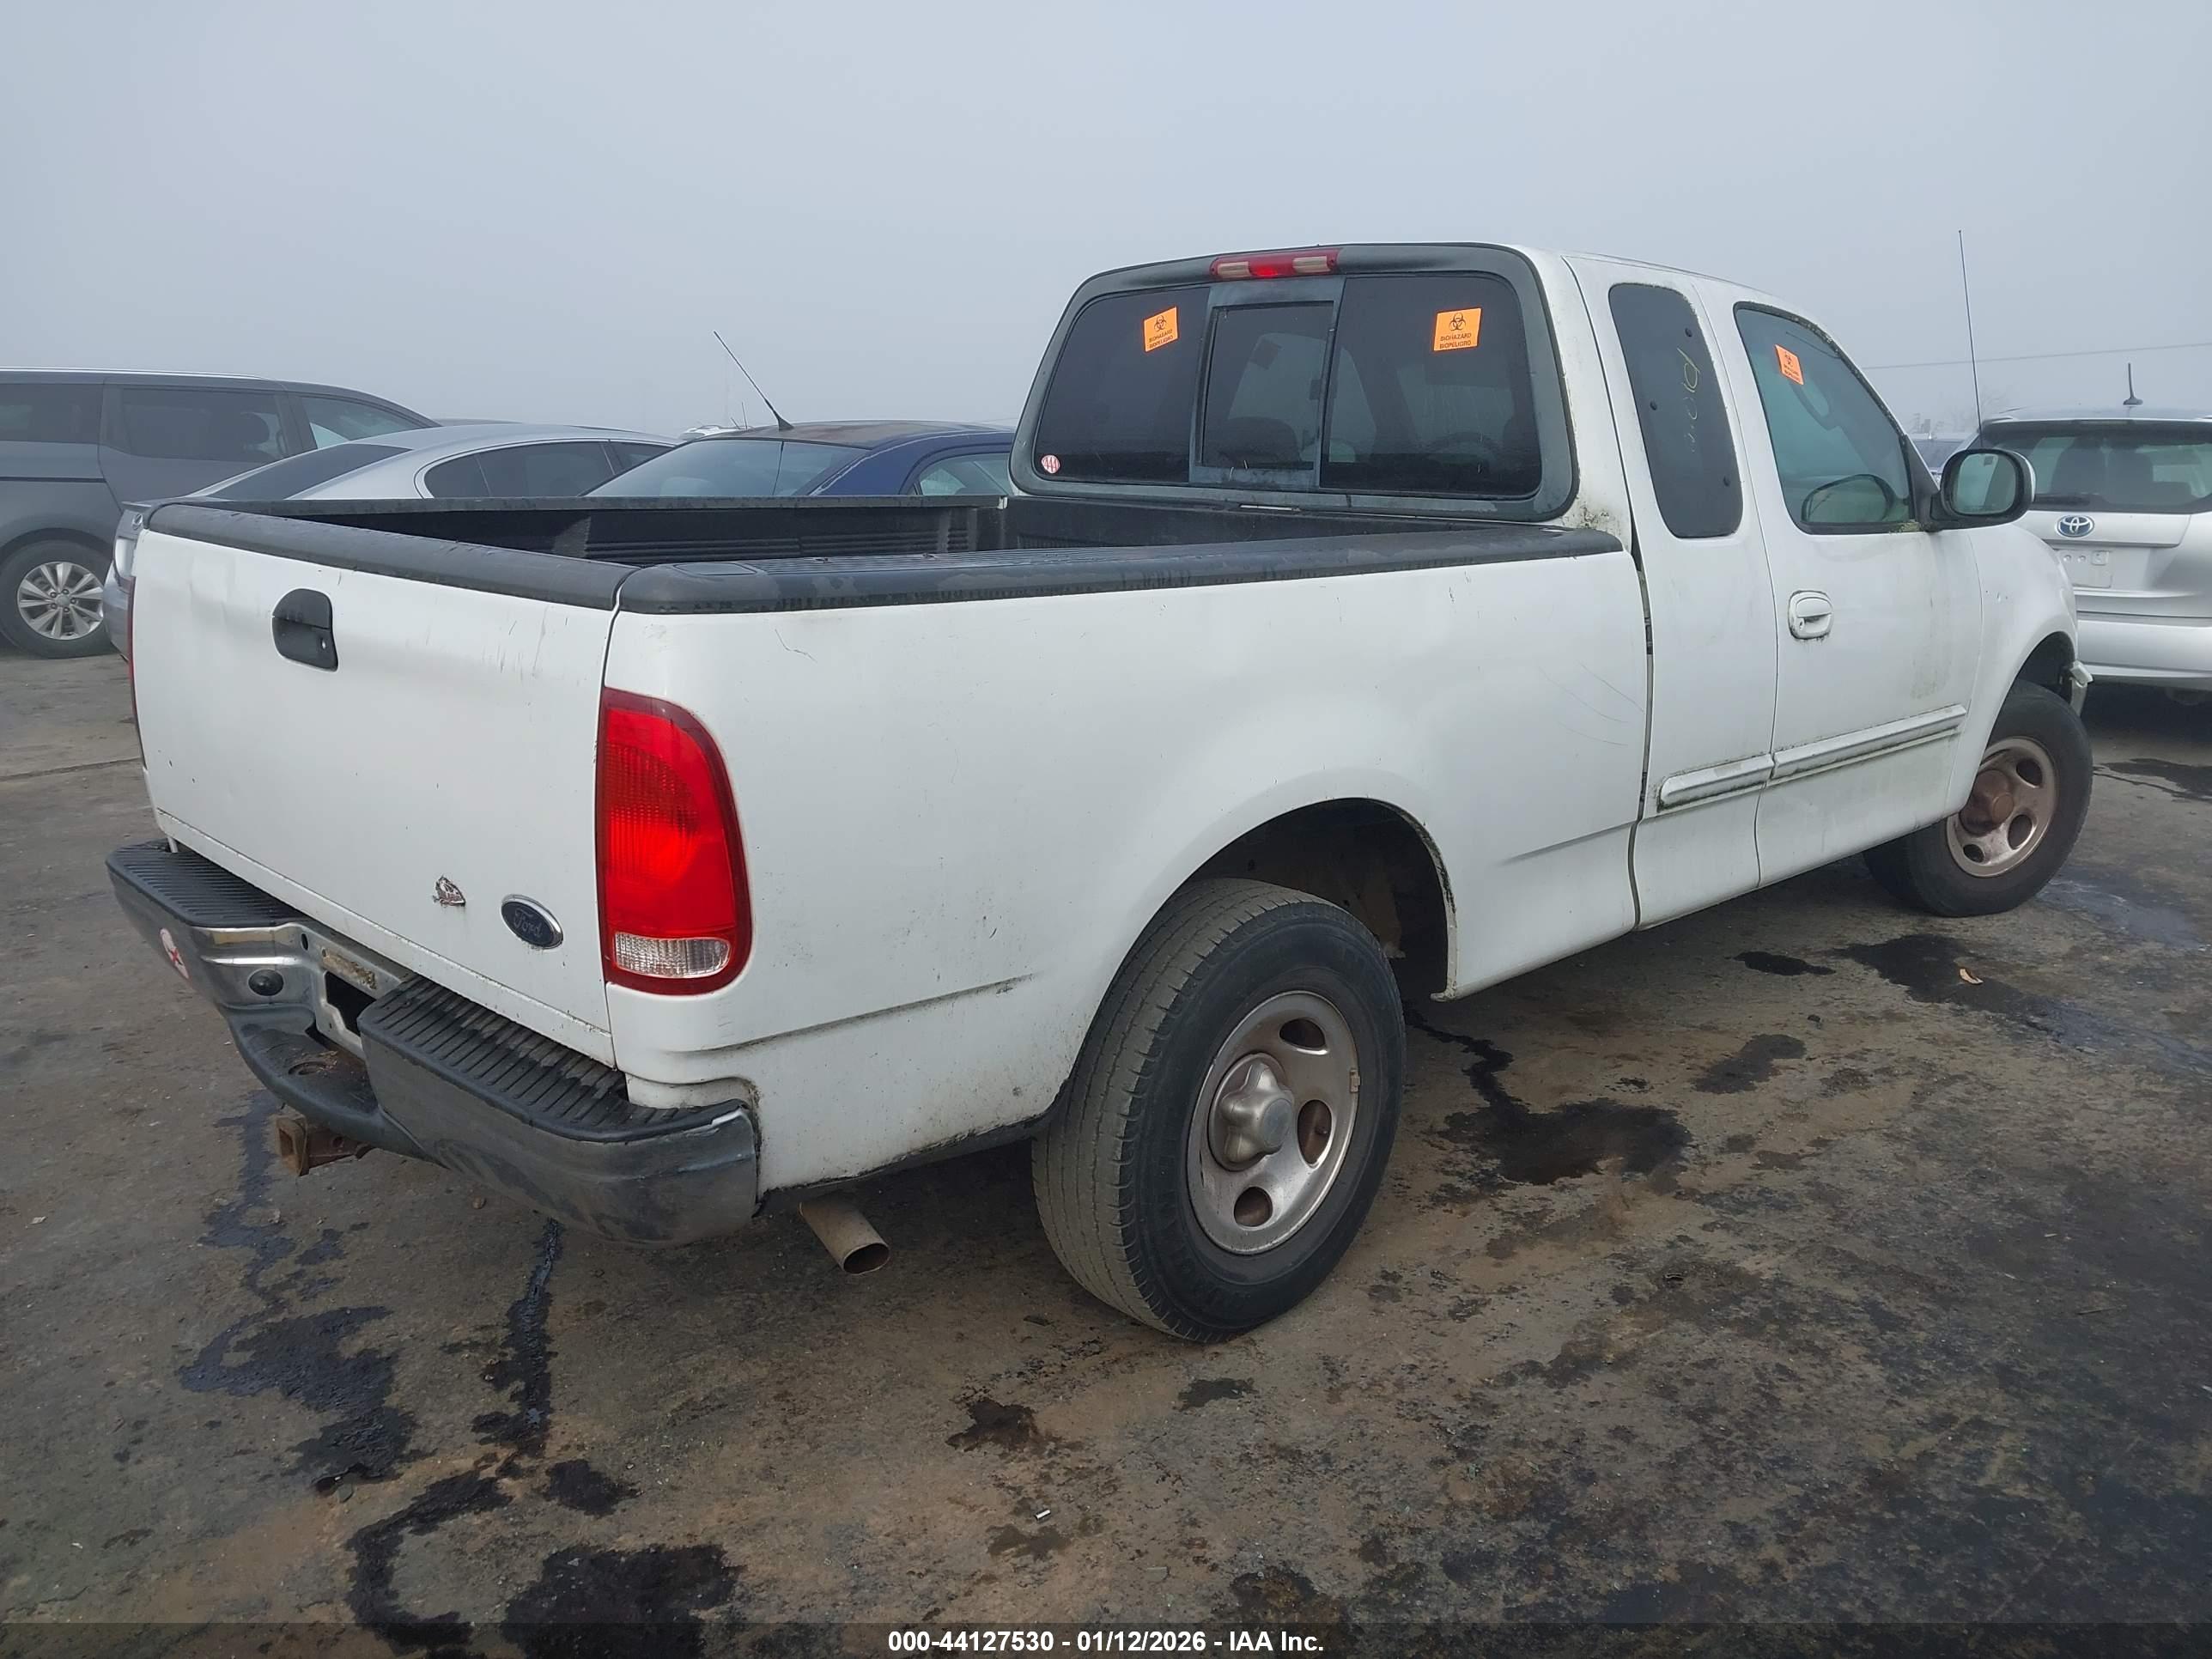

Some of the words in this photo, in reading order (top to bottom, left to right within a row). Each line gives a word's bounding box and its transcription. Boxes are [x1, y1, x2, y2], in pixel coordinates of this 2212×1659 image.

[1440, 332, 1472, 342] BIOHAZARD
[1439, 340, 1472, 349] BIOPELIGRO
[513, 908, 544, 938] Ford
